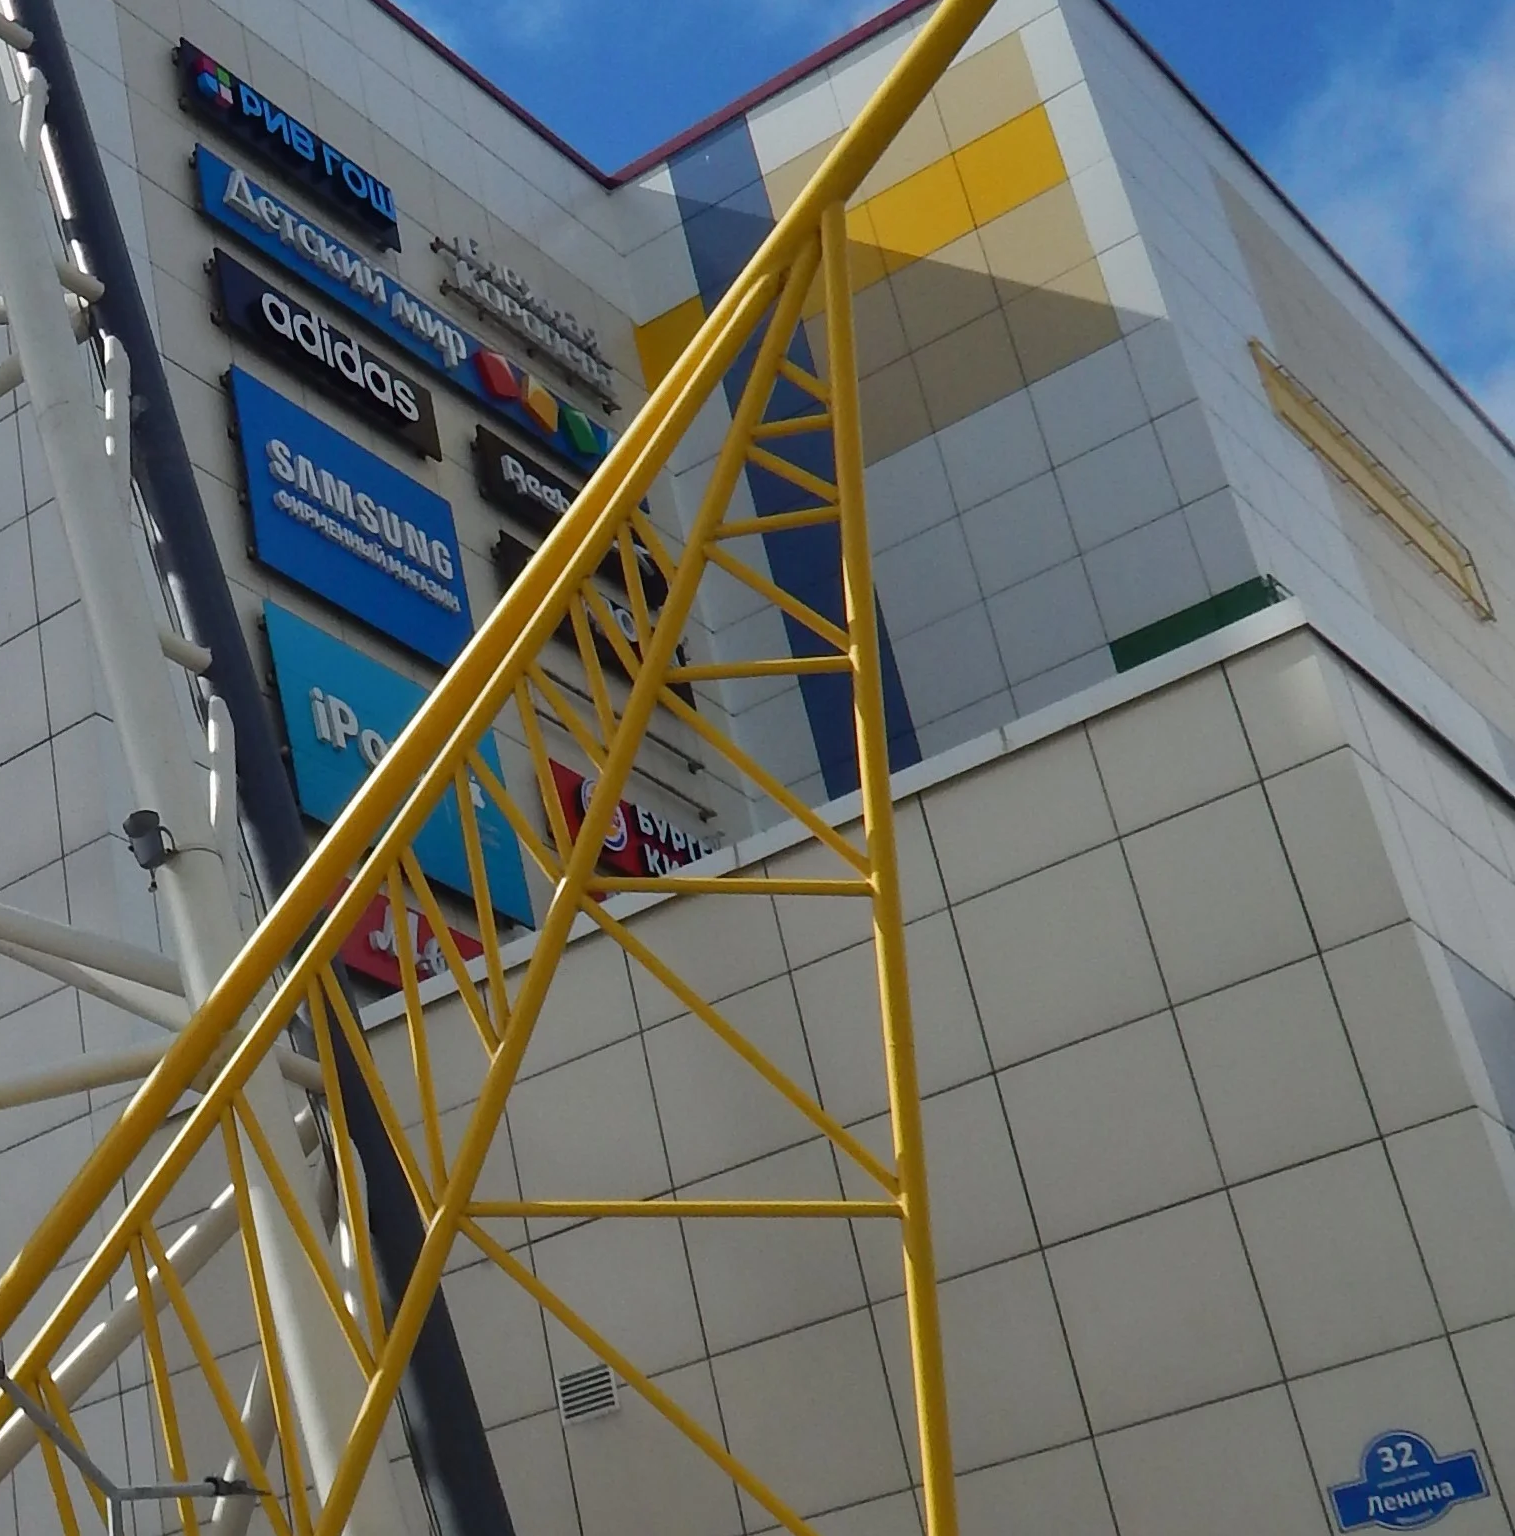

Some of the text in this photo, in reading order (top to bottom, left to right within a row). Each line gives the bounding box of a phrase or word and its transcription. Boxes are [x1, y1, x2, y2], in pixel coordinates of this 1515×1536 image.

[239, 82, 397, 225] РИВ ГОШ
[223, 168, 468, 367] Детский мир
[262, 293, 420, 422] adidas
[266, 439, 454, 580] SAMSUNG
[501, 454, 571, 514] Reeb
[1368, 1482, 1455, 1516] Ленина
[1377, 1442, 1418, 1473] 32
